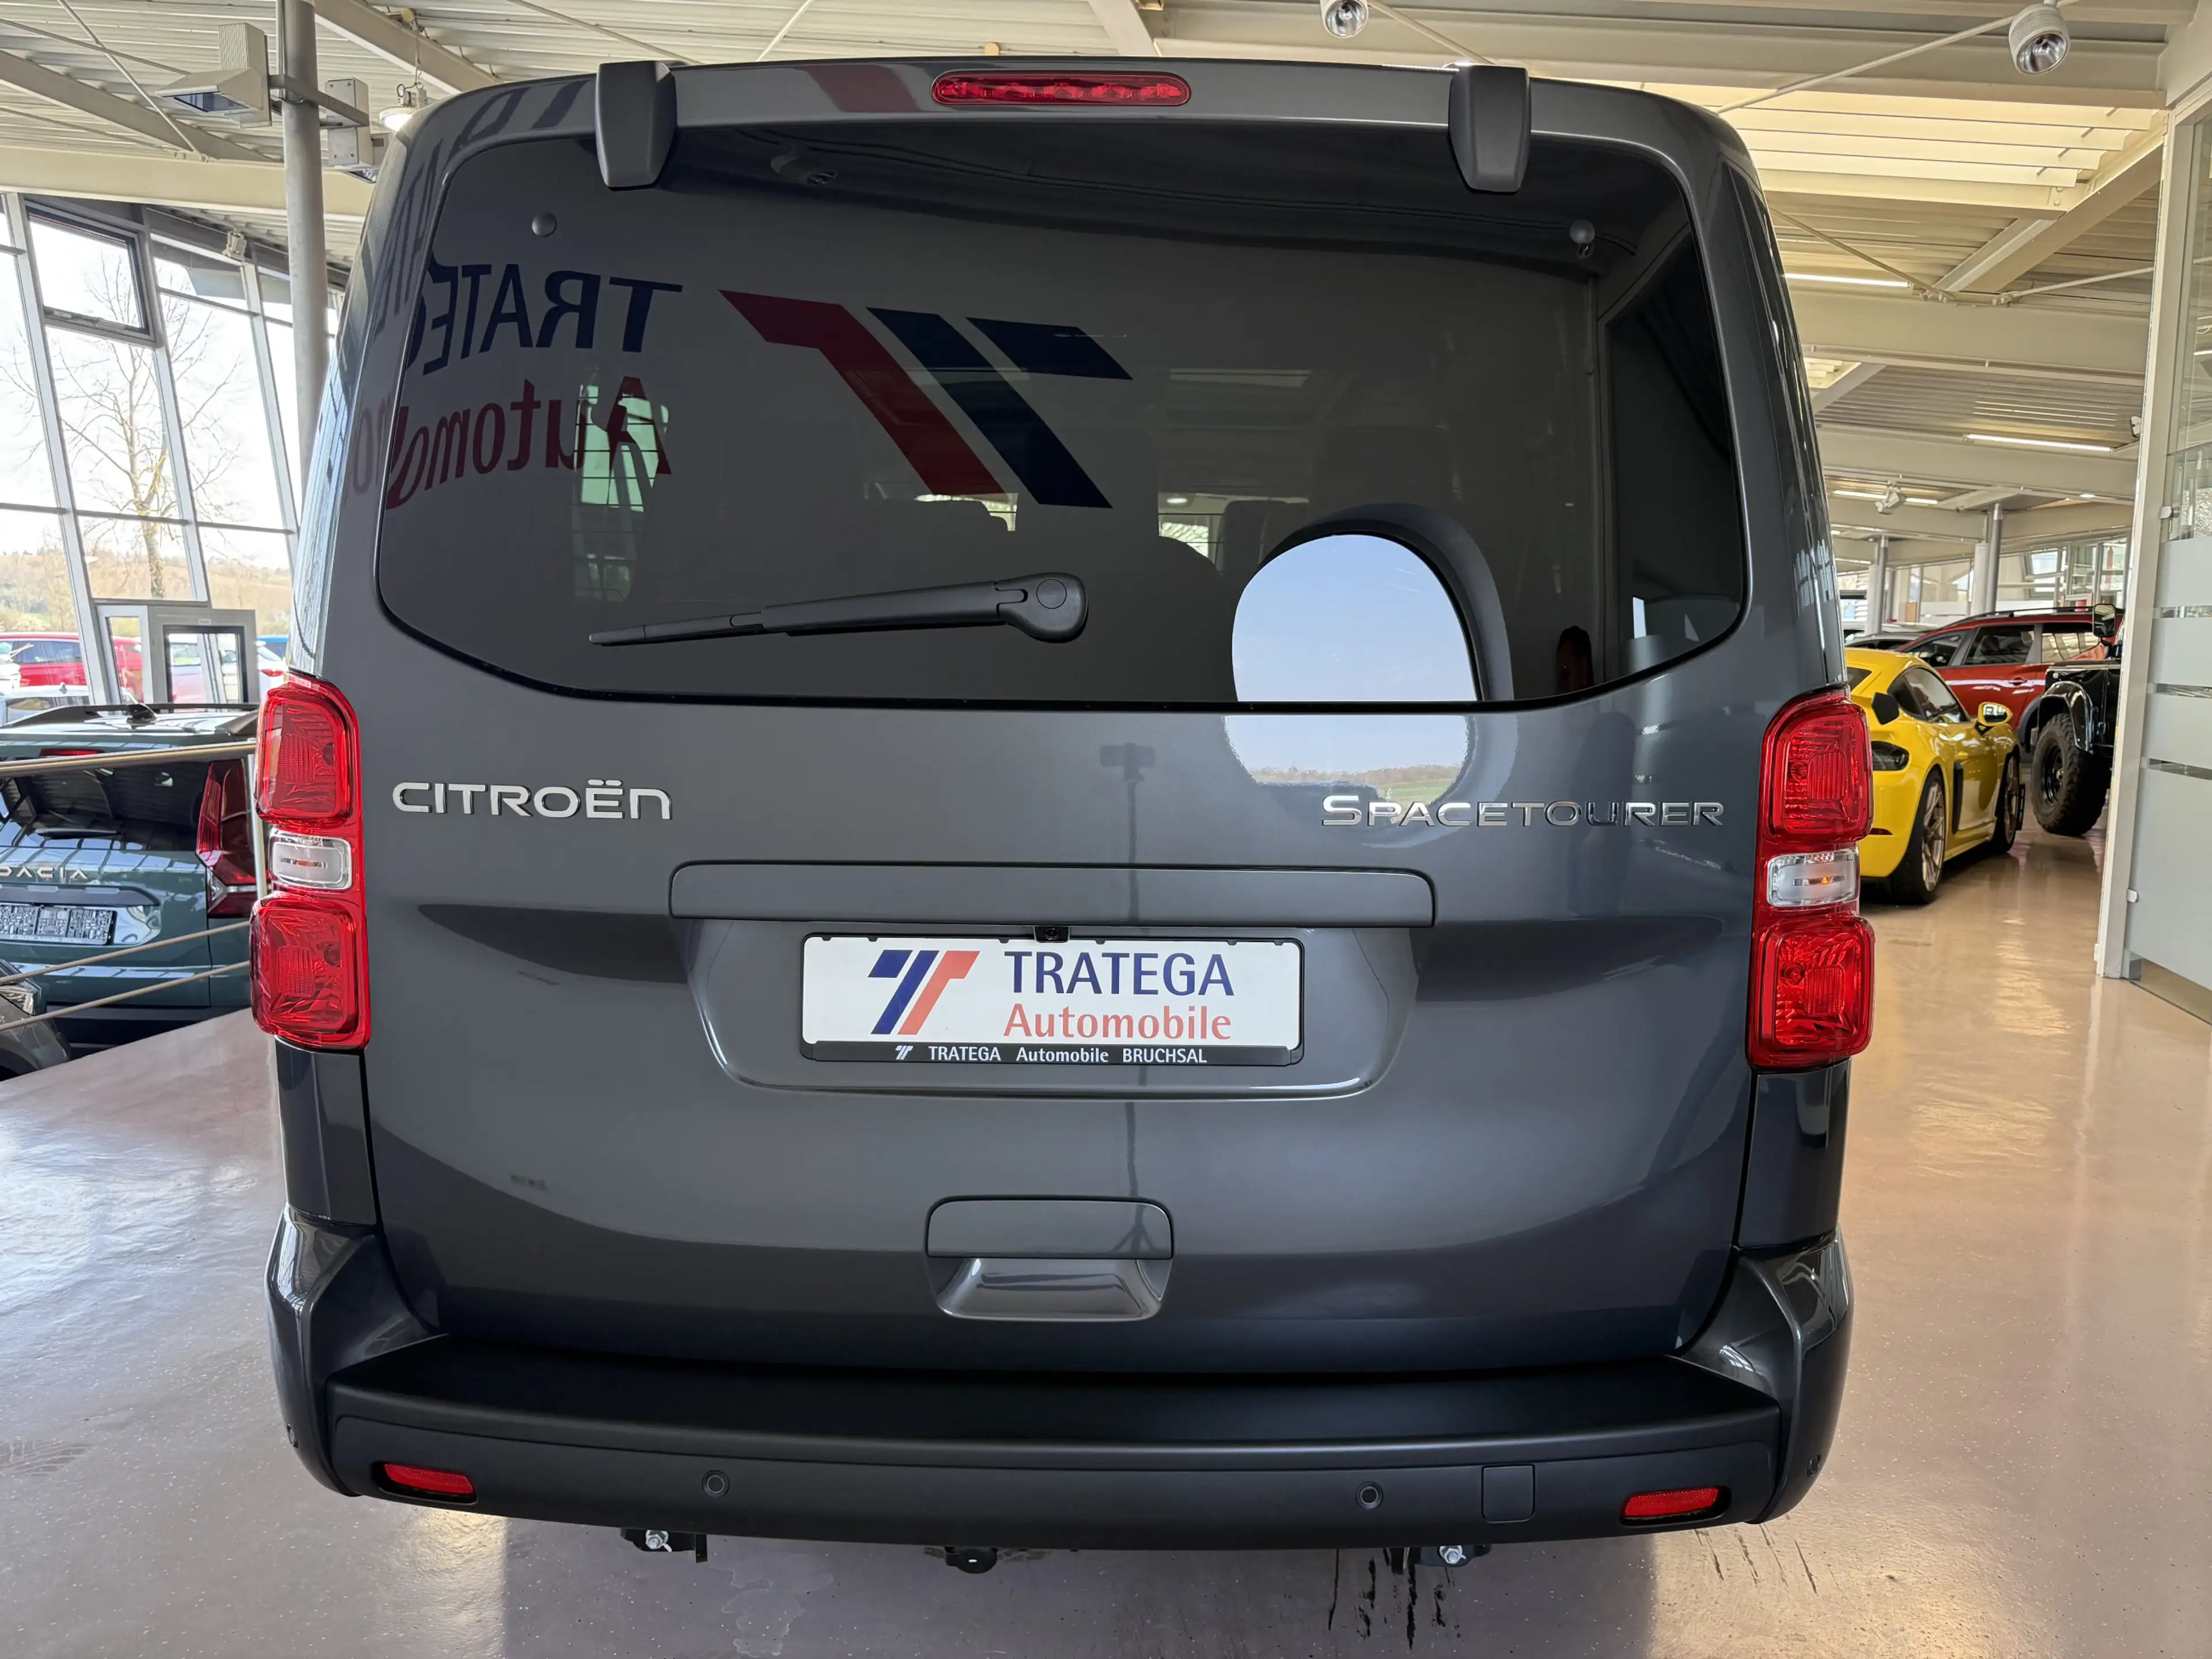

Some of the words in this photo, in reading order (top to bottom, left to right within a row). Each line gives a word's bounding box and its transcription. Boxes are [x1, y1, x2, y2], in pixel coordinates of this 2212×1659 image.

[1321, 795, 1725, 827] SPACETOURER
[1003, 951, 1234, 996] TRATEGA
[1003, 1003, 1232, 1040] Automobile
[928, 1046, 1001, 1062] TRATEGA
[1016, 1046, 1109, 1063] Automobile
[1122, 1046, 1207, 1063] BRUCHSAL
